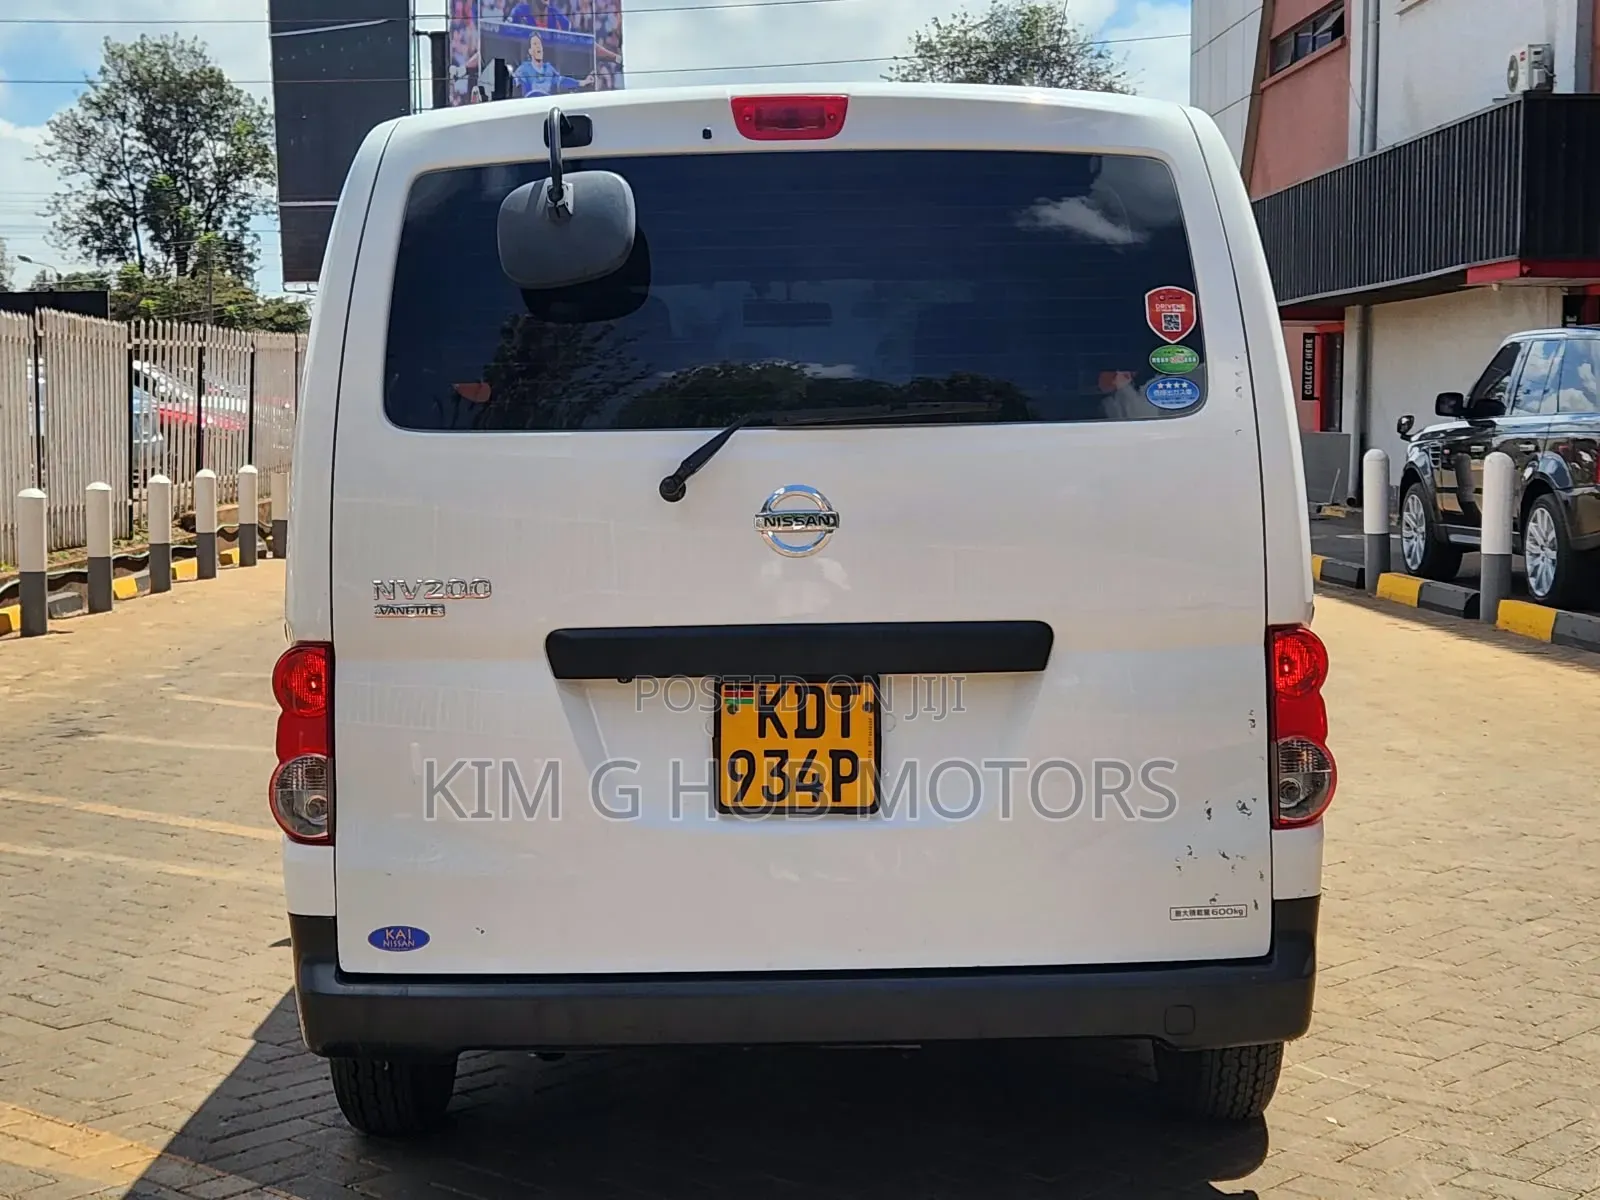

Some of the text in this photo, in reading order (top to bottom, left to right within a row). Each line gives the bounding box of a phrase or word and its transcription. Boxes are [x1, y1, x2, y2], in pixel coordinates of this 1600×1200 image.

[1304, 338, 1313, 395] COLLECT HERE
[764, 515, 830, 527] NISSAN
[372, 578, 492, 600] NV200
[378, 605, 439, 616] VANETTE
[757, 685, 861, 739] KDT
[727, 749, 859, 802] 934P
[385, 928, 411, 940] KAI
